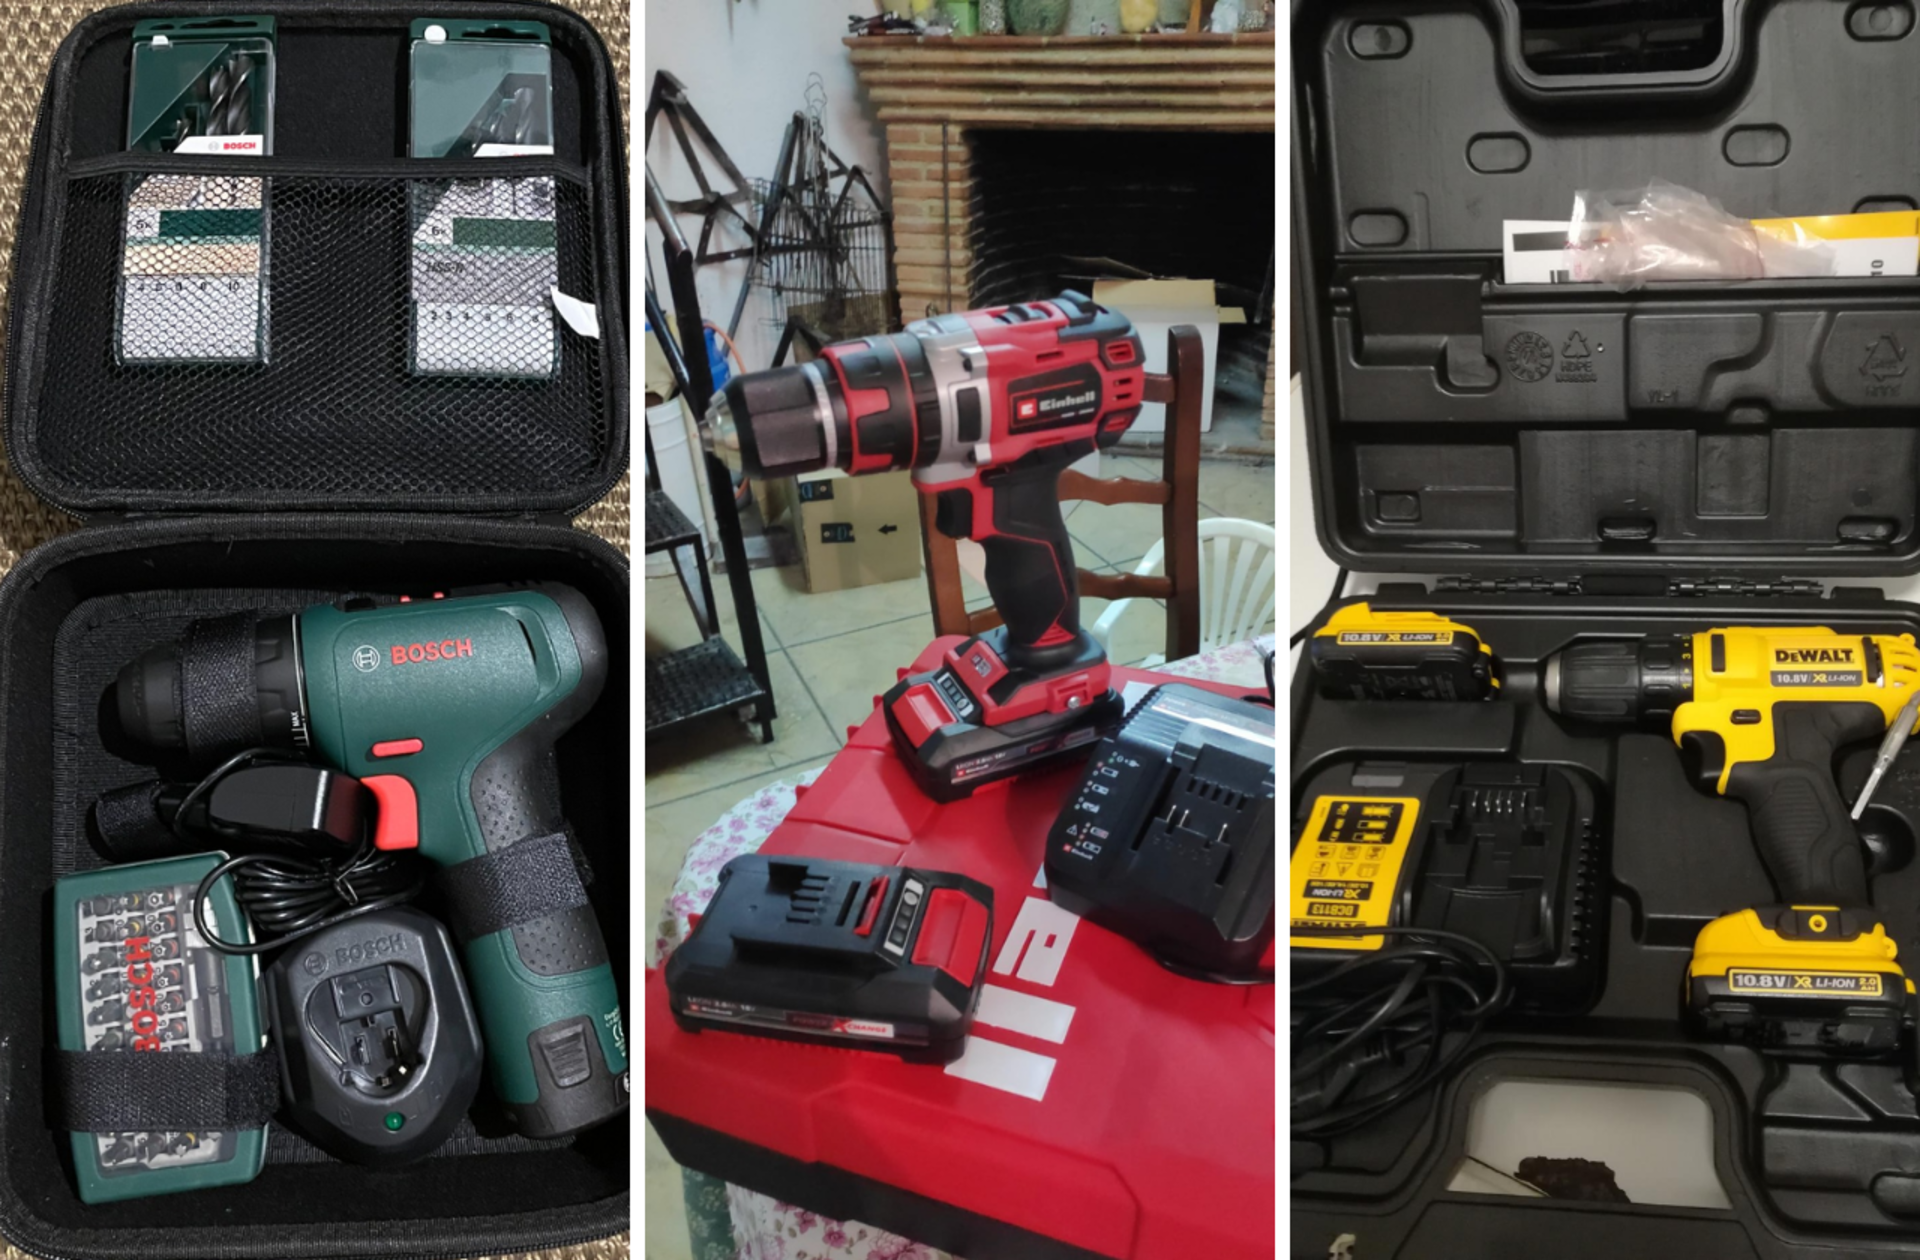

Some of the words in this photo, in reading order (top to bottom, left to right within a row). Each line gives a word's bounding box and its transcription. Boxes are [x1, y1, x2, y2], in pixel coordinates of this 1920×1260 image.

[223, 142, 256, 150] BOSCH
[1040, 391, 1096, 411] Einhell
[391, 638, 472, 665] BOSCH
[1828, 675, 1856, 683] LI-ION
[291, 711, 300, 727] MAX
[1312, 904, 1354, 914] DCB113
[336, 933, 406, 967] BOSCH
[1816, 977, 1855, 988] LI-ION
[124, 936, 160, 1052] BOSCH
